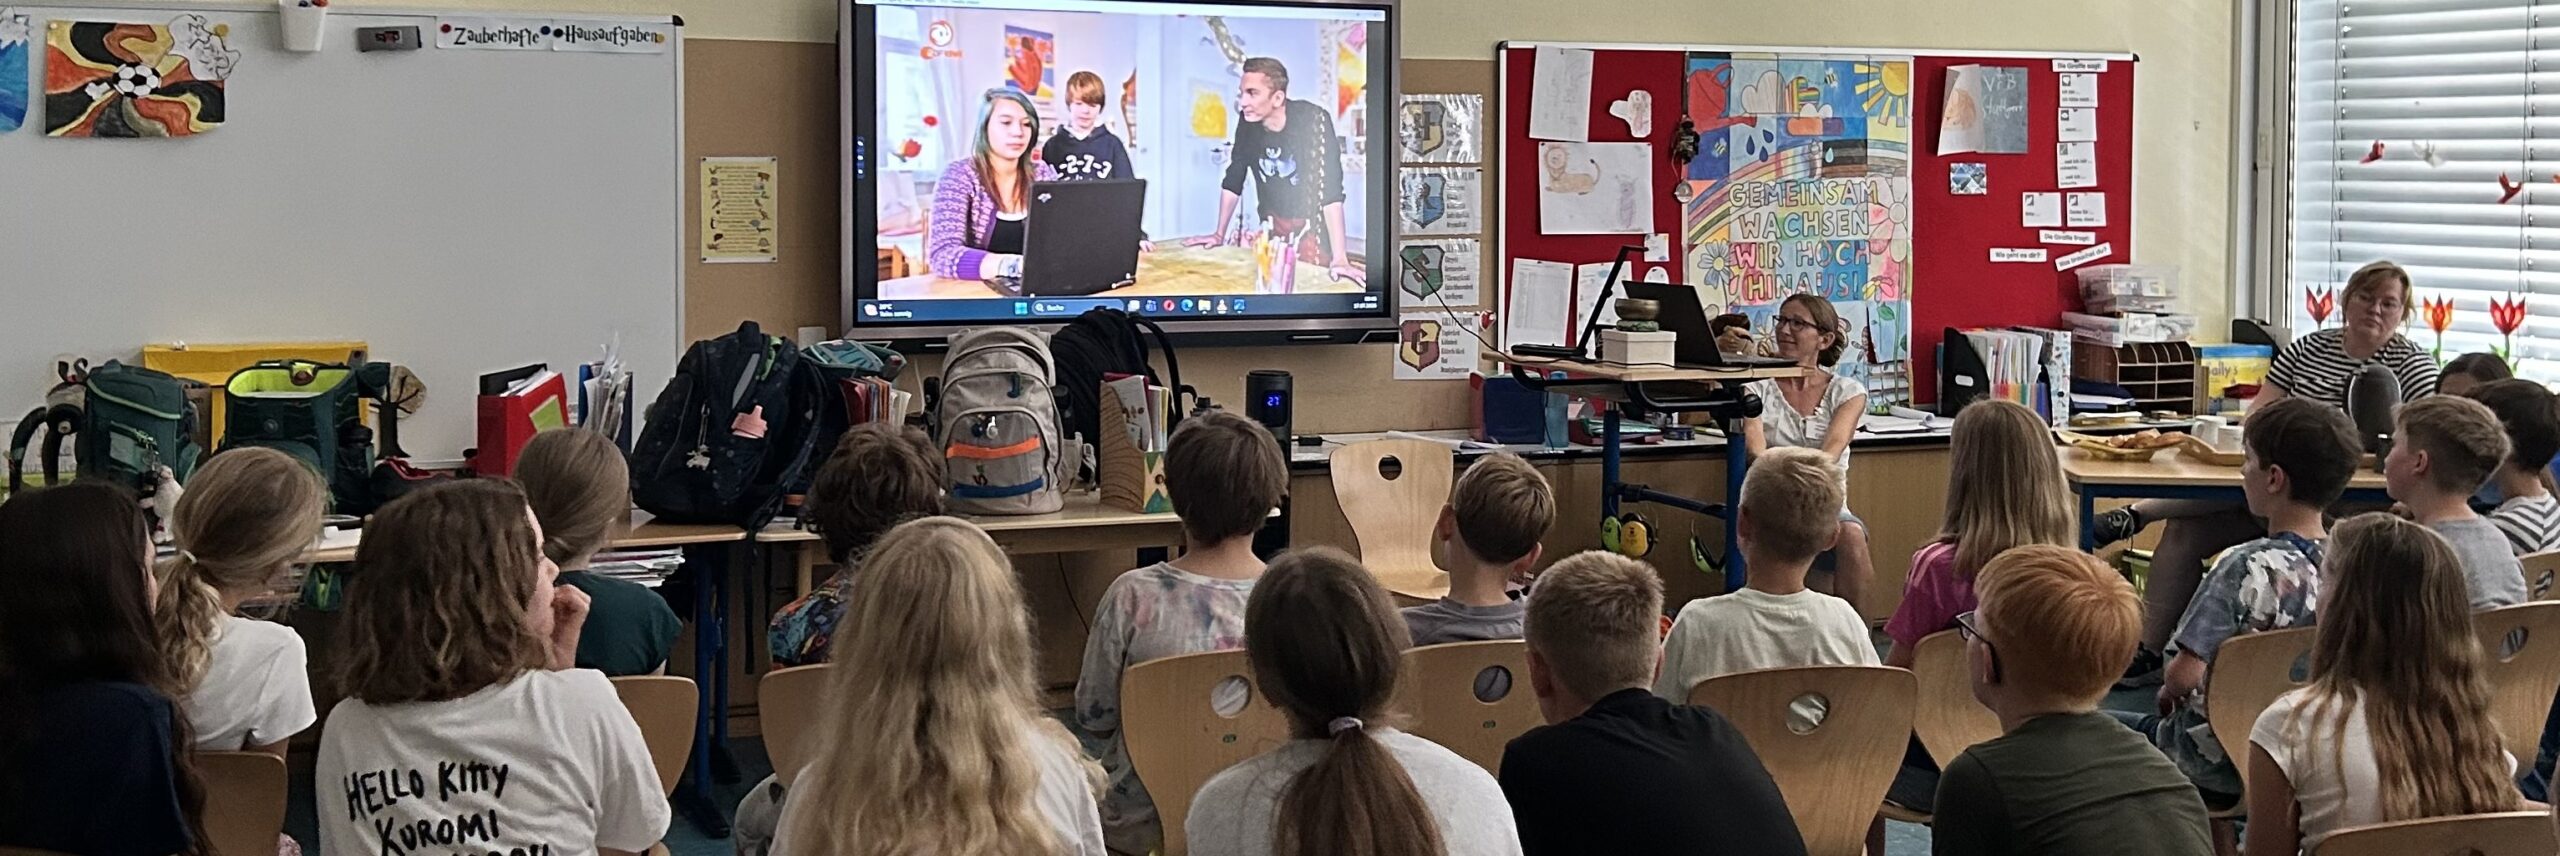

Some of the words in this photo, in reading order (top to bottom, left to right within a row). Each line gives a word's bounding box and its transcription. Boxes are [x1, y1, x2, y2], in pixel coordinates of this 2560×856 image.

[453, 26, 540, 47] Zauberhafte
[565, 25, 657, 47] Hausaufgaben
[1729, 180, 1878, 208] GEMEINSAM
[1738, 209, 1869, 240] WACHSEN
[1735, 241, 1784, 269] WIR
[1795, 238, 1871, 268] HOCH
[1746, 271, 1859, 300] HINAUS!
[1266, 396, 1280, 406] 27
[344, 769, 425, 822] HELLO
[438, 761, 509, 801] KITTY
[375, 809, 500, 856] KUROMI
